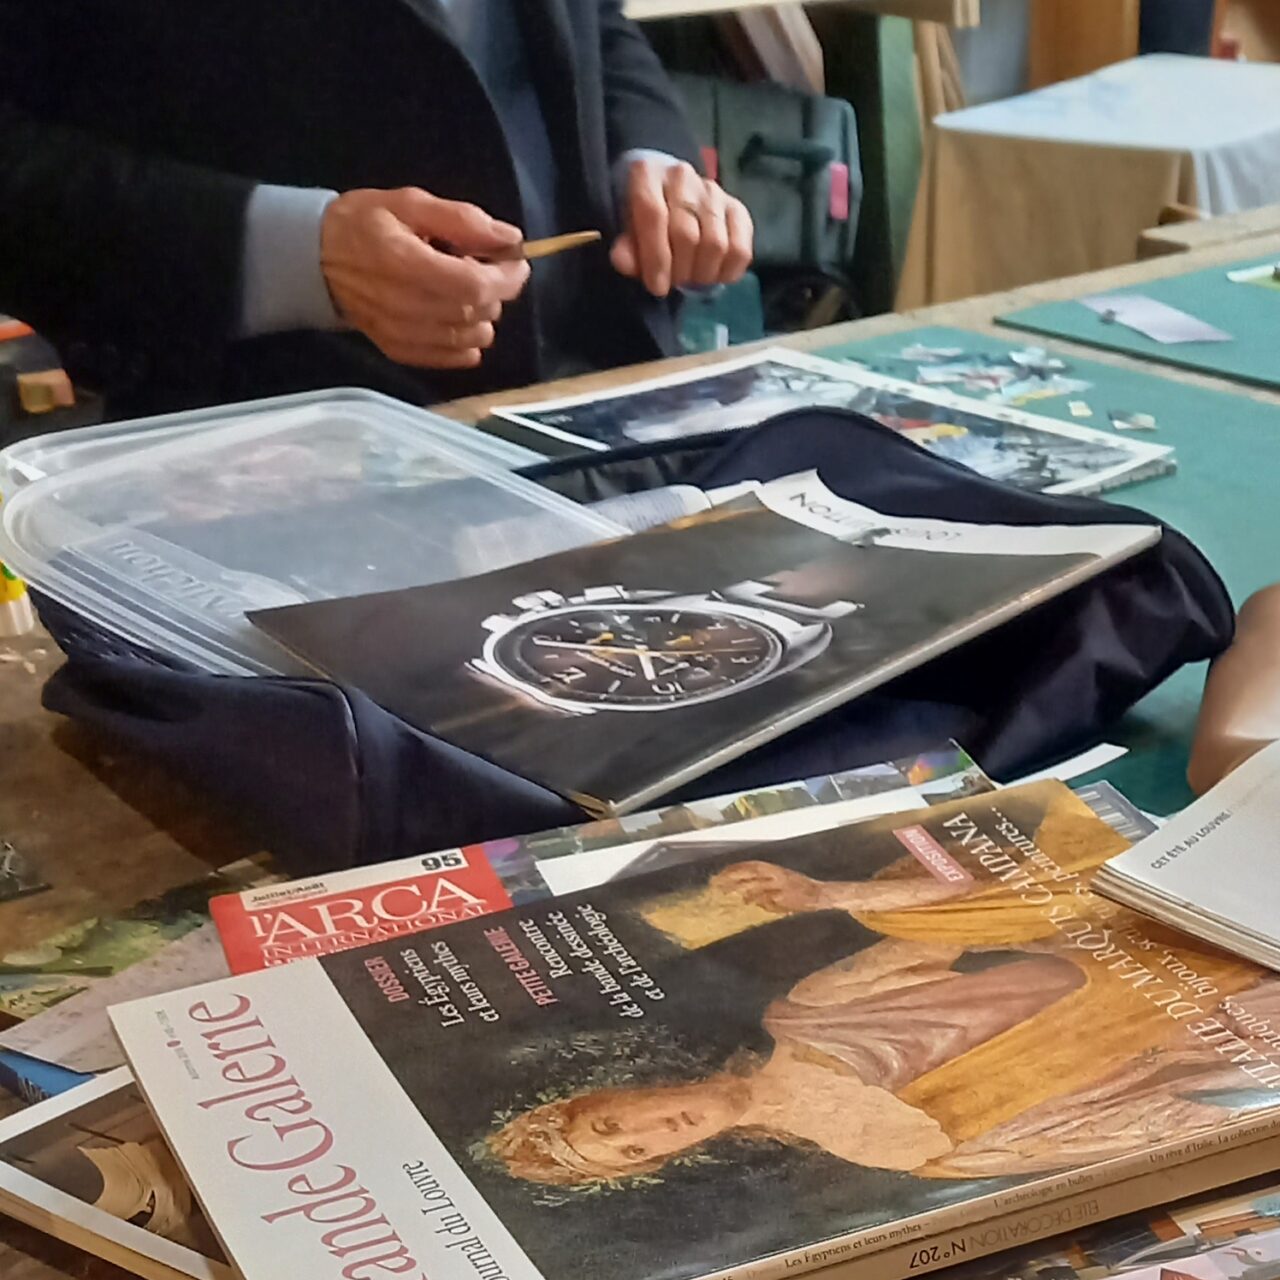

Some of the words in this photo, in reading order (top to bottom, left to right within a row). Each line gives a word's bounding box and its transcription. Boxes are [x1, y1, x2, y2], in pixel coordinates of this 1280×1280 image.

[421, 852, 462, 872] 95
[903, 829, 964, 883] EXPOSITION
[942, 812, 1053, 905] CAMPANA
[484, 926, 525, 969] GALERIE
[519, 919, 573, 980] Rencontre
[549, 911, 590, 959] dessinée
[1041, 905, 1163, 990] MARQUIS
[363, 954, 410, 1004] DOSSIER
[400, 948, 449, 1006] Égyptiens
[431, 941, 470, 983] mythes
[582, 959, 621, 995] bande
[630, 971, 655, 989] de
[1157, 950, 1219, 999] bijoux,
[460, 978, 487, 1012] leurs
[513, 967, 559, 1008] PETITE
[645, 986, 666, 1001] et
[1144, 988, 1203, 1021] DU
[441, 1003, 465, 1028] Les
[480, 1008, 500, 1024] et
[620, 1002, 645, 1019] de
[1149, 1152, 1164, 1164] Un
[403, 1160, 454, 1215] Louvre
[434, 1212, 471, 1236] du
[784, 1255, 802, 1269] Les
[852, 1237, 863, 1249] et
[864, 1230, 888, 1247] leurs
